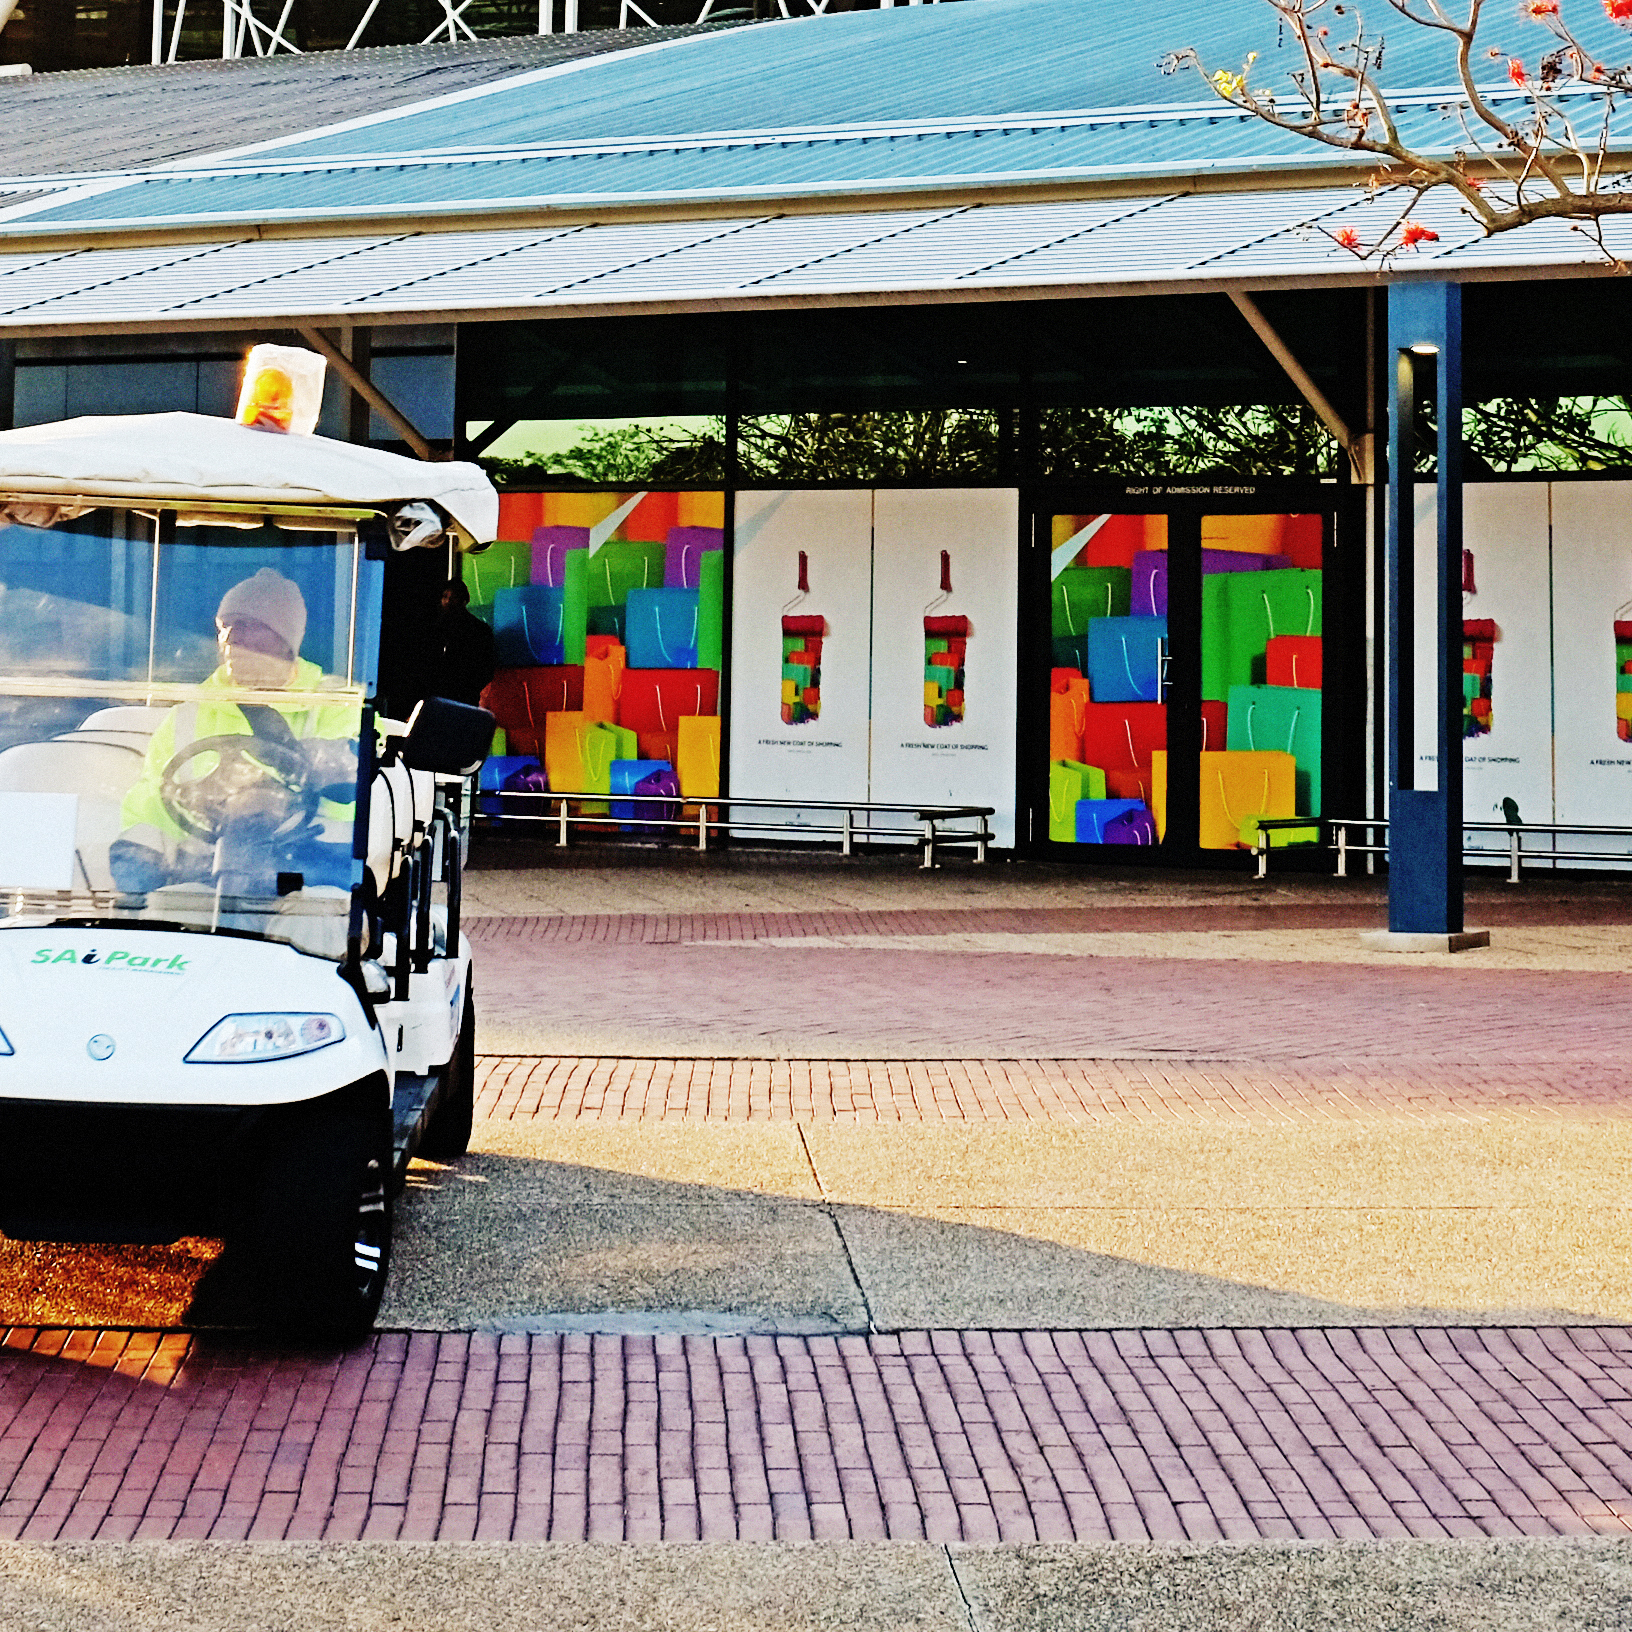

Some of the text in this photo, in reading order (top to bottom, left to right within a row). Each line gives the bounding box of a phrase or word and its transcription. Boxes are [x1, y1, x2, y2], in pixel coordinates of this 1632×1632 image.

[1125, 486, 1256, 494] RIGHT OF ADMISSION RESERVED
